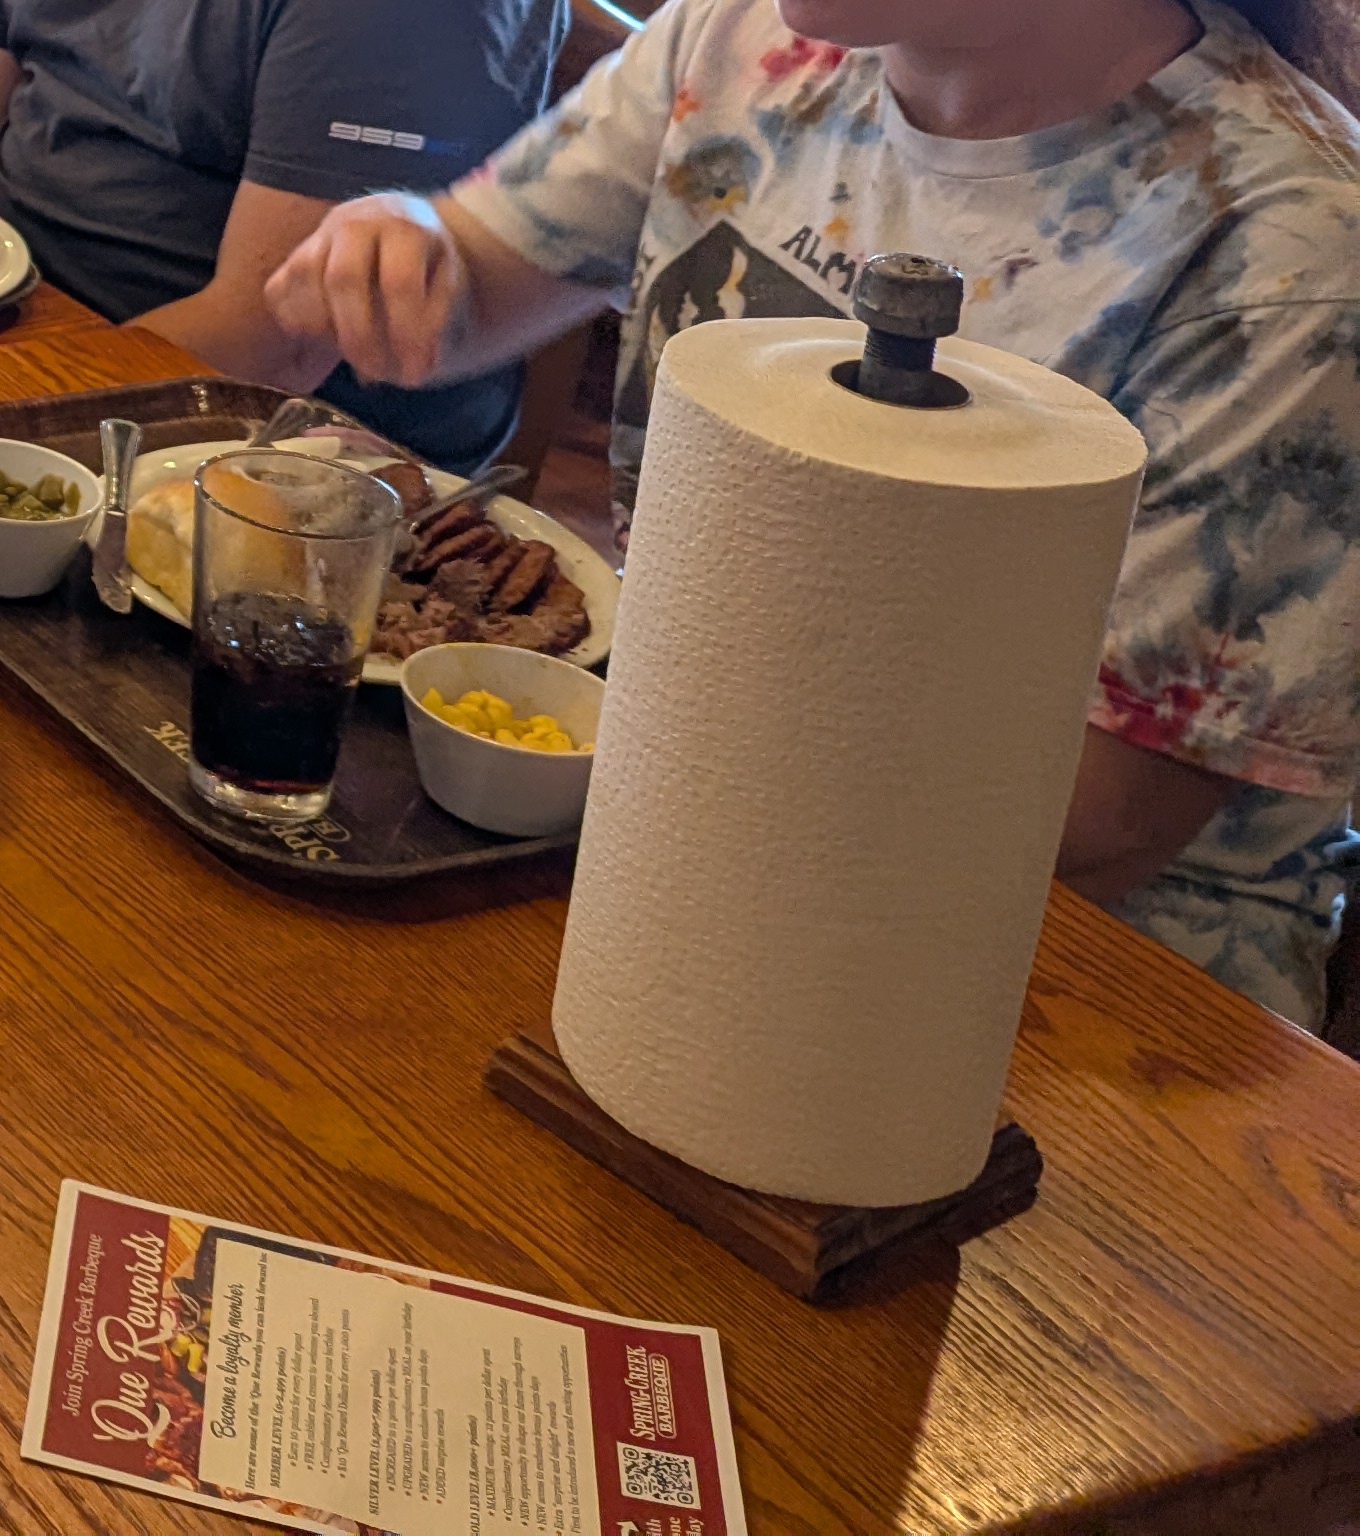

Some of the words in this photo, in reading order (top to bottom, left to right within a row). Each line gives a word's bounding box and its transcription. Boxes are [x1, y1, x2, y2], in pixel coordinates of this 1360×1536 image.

[329, 122, 424, 151] 959
[79, 1234, 103, 1293] Barbeque
[73, 1296, 93, 1333] Creek
[96, 1230, 174, 1362] Rewards
[224, 1284, 242, 1328] member
[66, 1336, 92, 1381] Spring
[217, 1330, 250, 1373] loyalty
[61, 1384, 81, 1415] Join
[224, 1376, 236, 1385] a
[652, 1359, 672, 1431] BARBEQUE
[210, 1387, 235, 1437] Become
